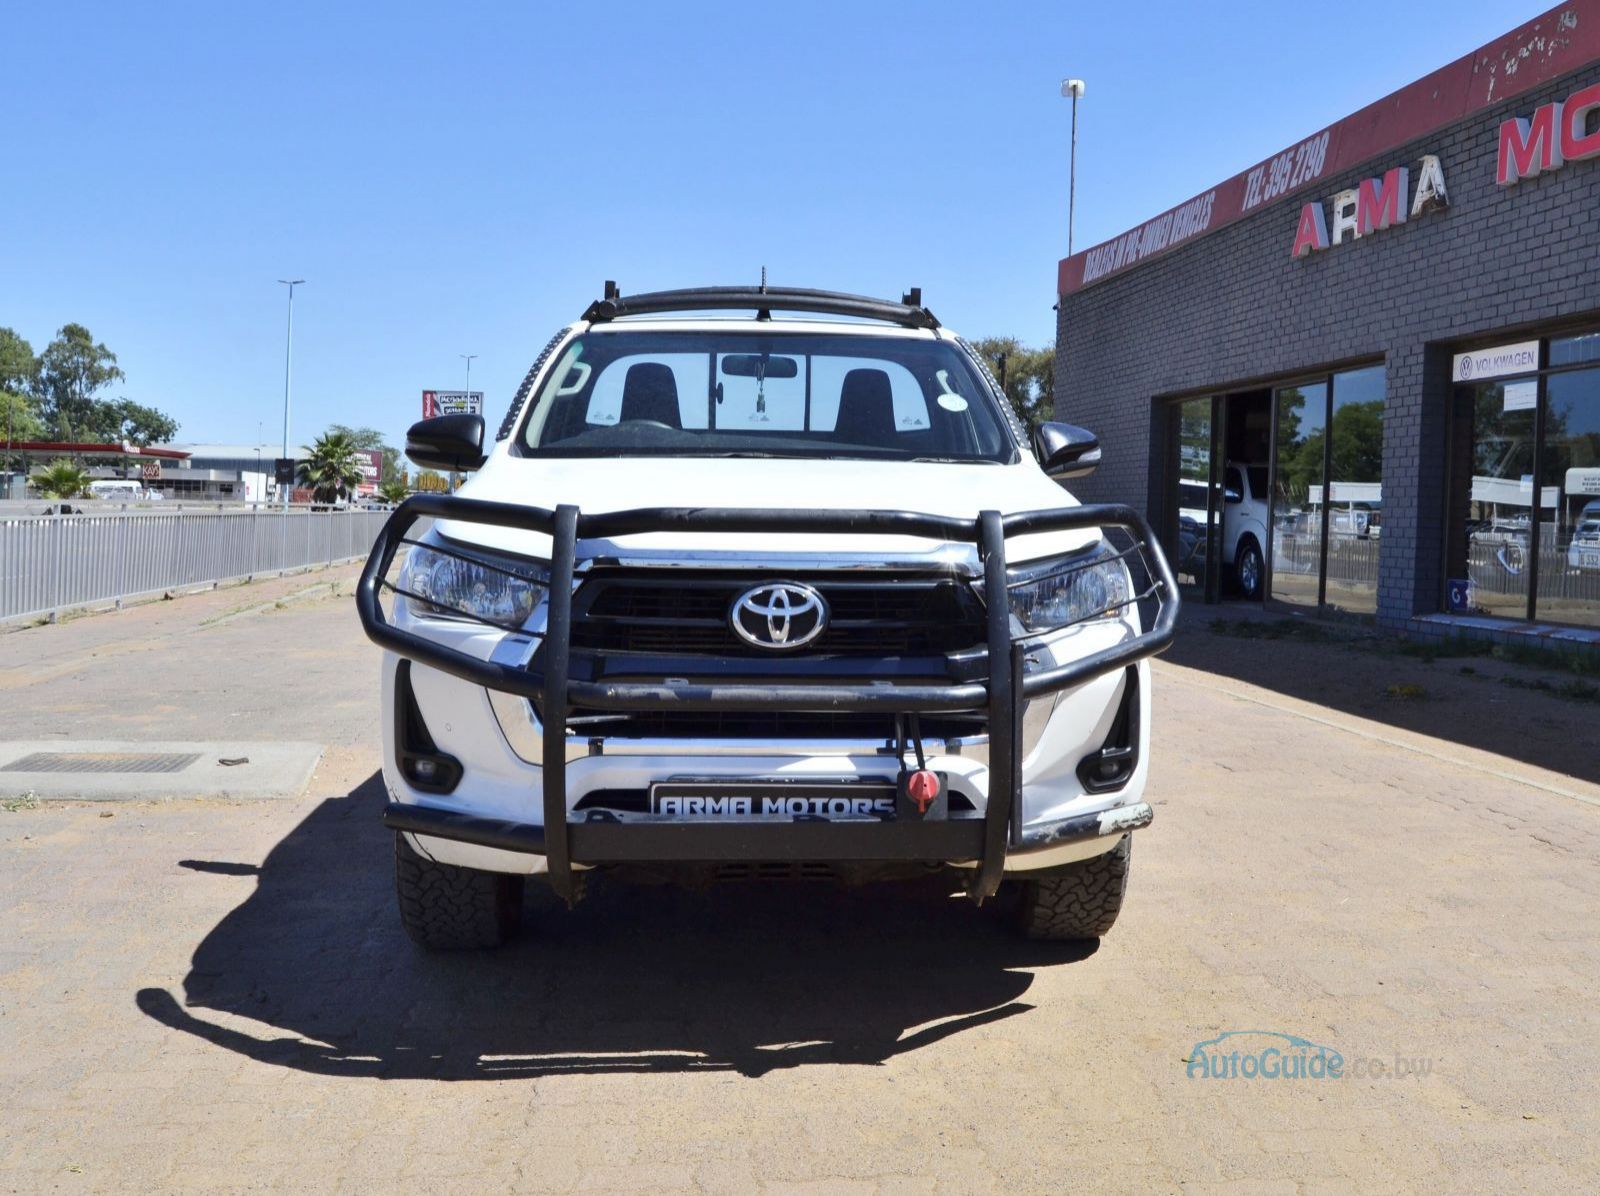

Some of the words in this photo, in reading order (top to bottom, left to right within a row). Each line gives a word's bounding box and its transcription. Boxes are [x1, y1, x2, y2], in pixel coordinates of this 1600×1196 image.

[1263, 150, 1295, 201] 395
[1289, 130, 1330, 189] 2798
[1083, 243, 1115, 284] DEALERS
[1112, 235, 1127, 271] IN
[1122, 212, 1173, 267] PRE-OWNED
[1169, 190, 1215, 246] VEHICLES
[1292, 154, 1450, 258] ARMA
[1475, 351, 1535, 372] VOLKWAGEN
[659, 796, 752, 817] ARMA
[761, 797, 896, 817] MOTORS
